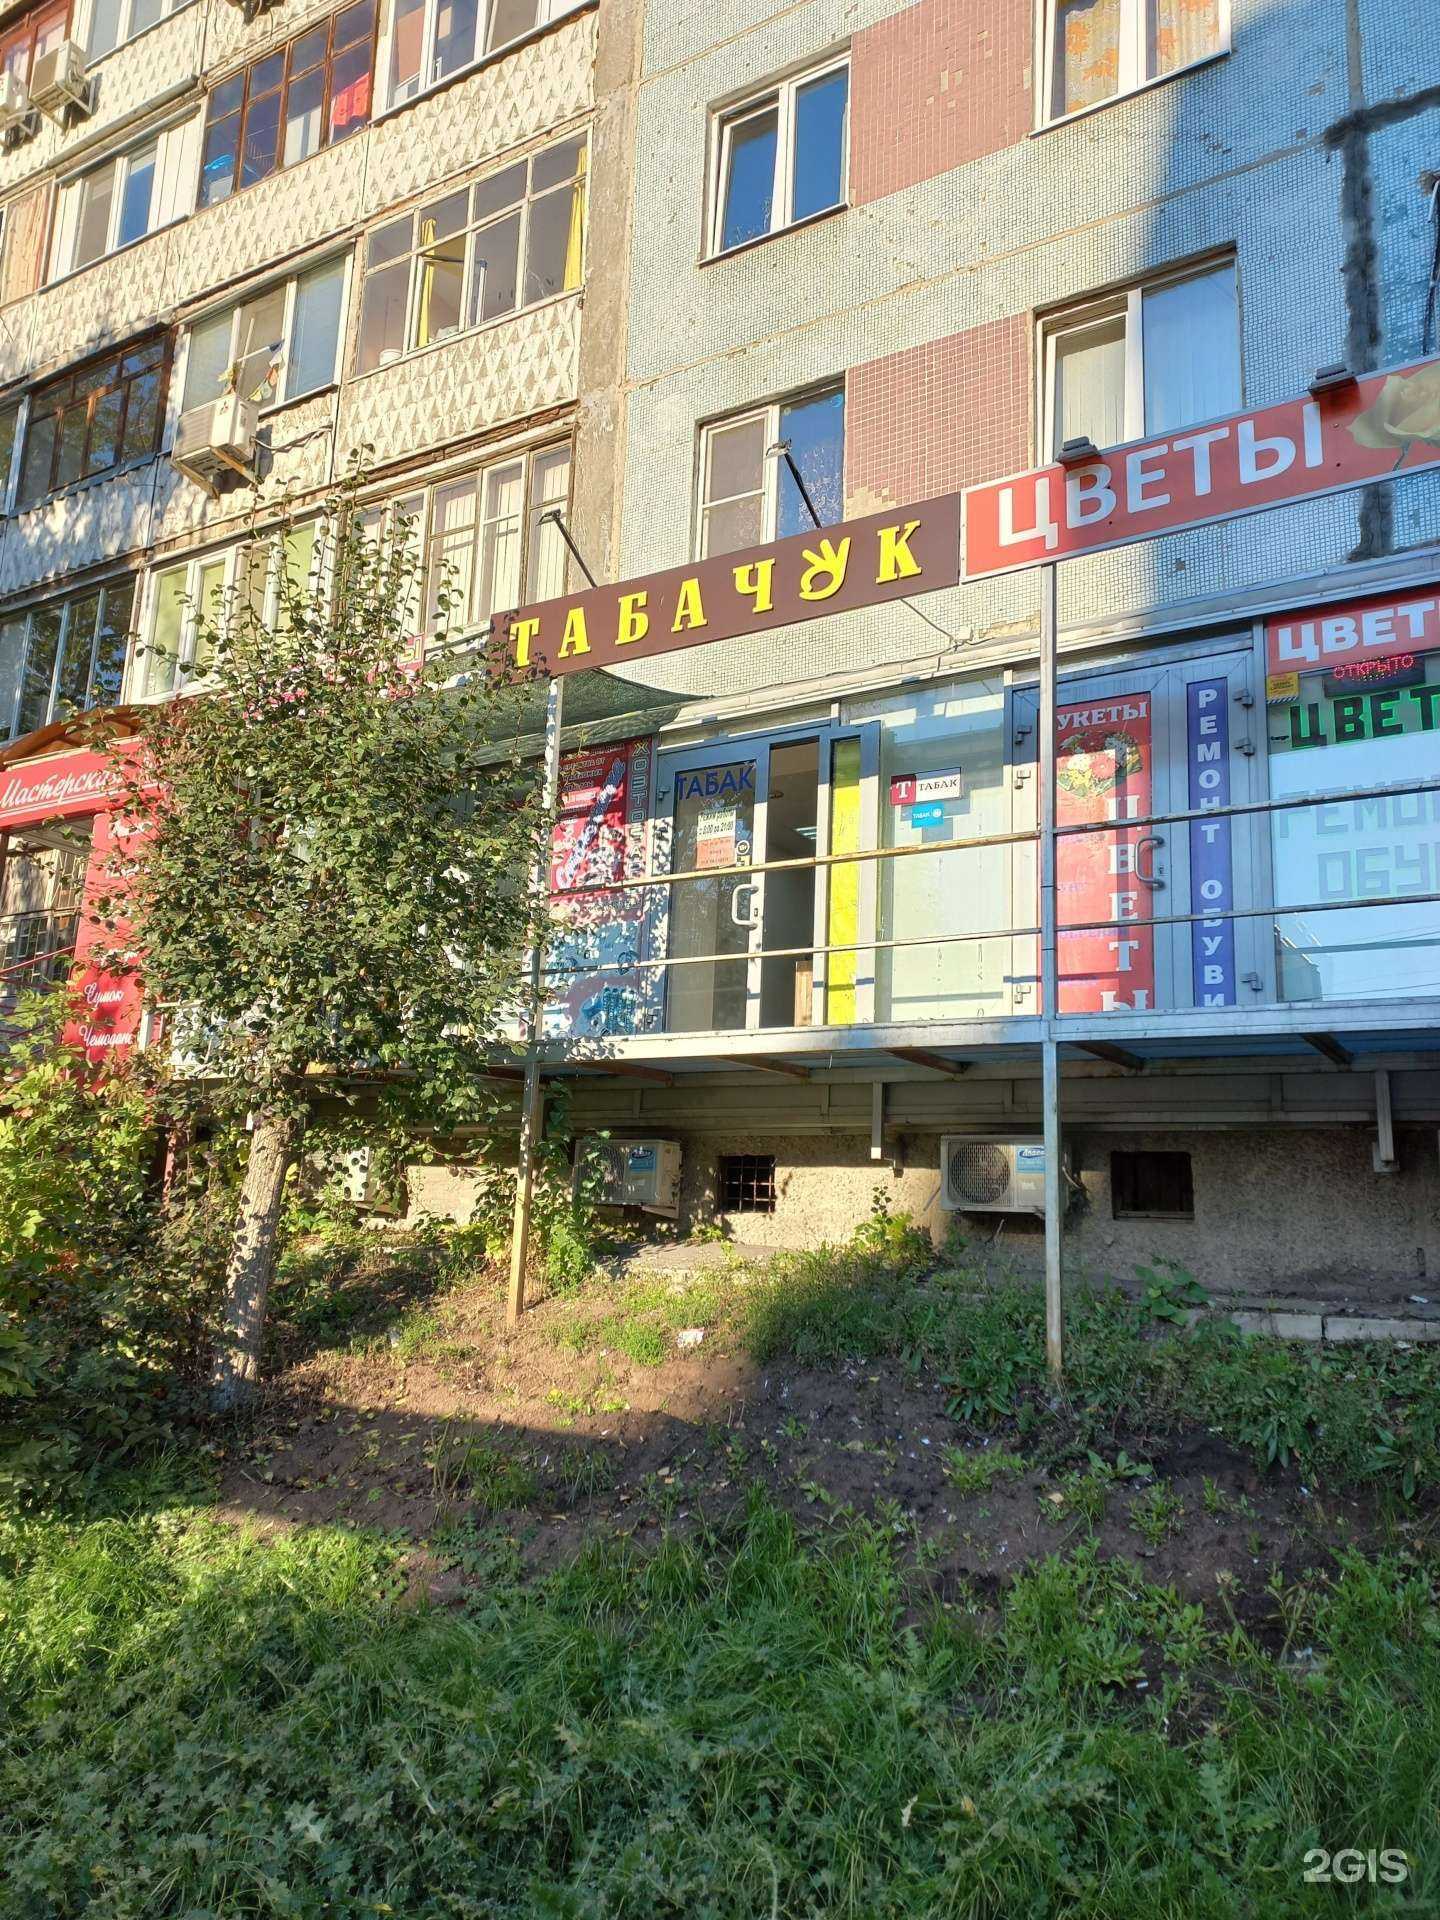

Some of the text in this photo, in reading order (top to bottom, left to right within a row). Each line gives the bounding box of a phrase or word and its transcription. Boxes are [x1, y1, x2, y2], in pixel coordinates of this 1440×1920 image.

[998, 401, 1325, 550] ЦВЕТЫ
[1278, 600, 1440, 662] ЦВЕТ
[1333, 654, 1414, 680] ОТКРЫТО
[1057, 701, 1148, 731] УКЕТЫ
[677, 767, 753, 800] ТАБАК
[918, 778, 957, 791] ТАБАК
[1278, 774, 1440, 839] РЕМО
[1196, 688, 1226, 1008] РЕМОНТ ОБУВИ
[1318, 841, 1440, 899] ОБУ
[1099, 795, 1150, 1012] ЦВЕТЫ
[84, 982, 125, 1008] Сумок
